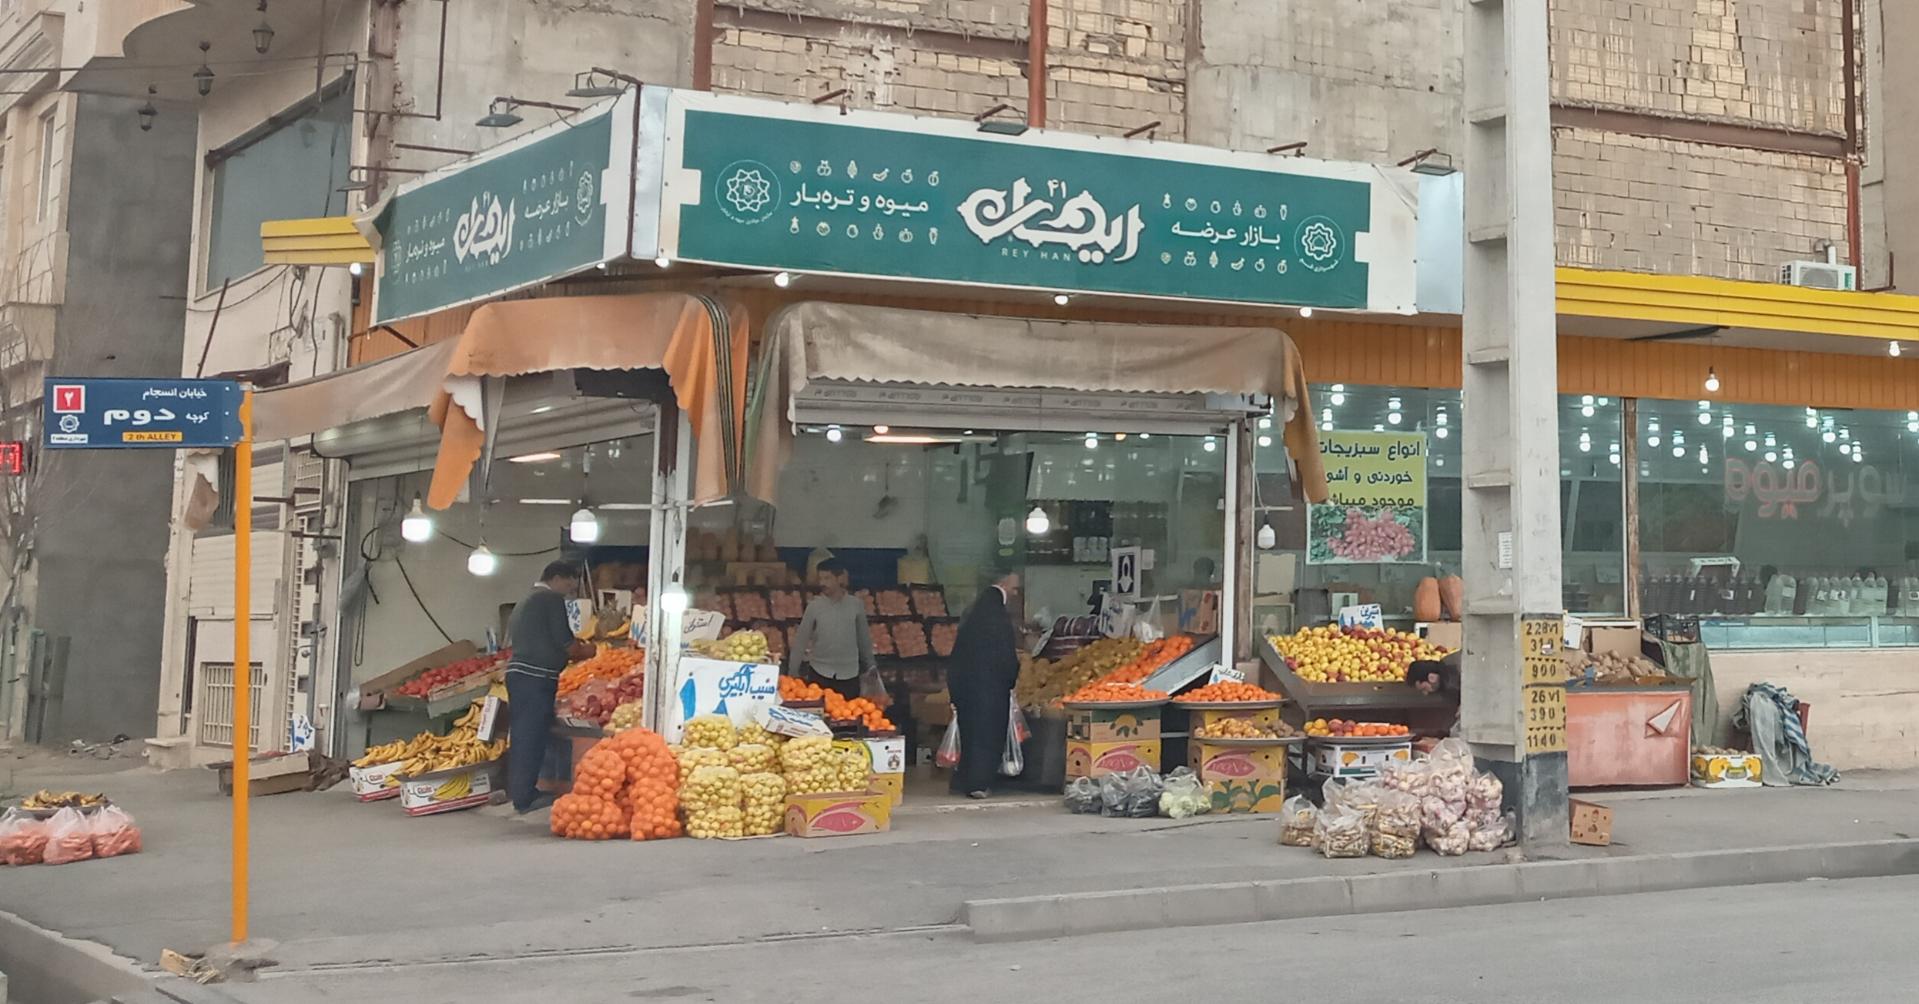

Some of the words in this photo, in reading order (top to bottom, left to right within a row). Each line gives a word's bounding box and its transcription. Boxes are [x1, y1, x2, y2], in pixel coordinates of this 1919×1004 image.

[860, 196, 869, 212] و
[875, 194, 930, 217] میوه
[1171, 221, 1238, 245] عرضه
[1239, 225, 1281, 249] بازار
[1001, 247, 1029, 258] REY
[1040, 251, 1071, 261] HAN
[142, 387, 178, 400] انسجام
[179, 388, 207, 398] خیابان
[104, 407, 176, 425] دوم
[186, 411, 210, 424] کوچه
[147, 433, 177, 441] ALLEY
[1387, 440, 1420, 461] انواع
[1353, 472, 1361, 484] و
[1367, 470, 1413, 485] خوردنی
[1371, 497, 1414, 509] موجود
[1532, 663, 1556, 678] 900
[1531, 689, 1546, 704] 26
[1530, 706, 1555, 721] 390
